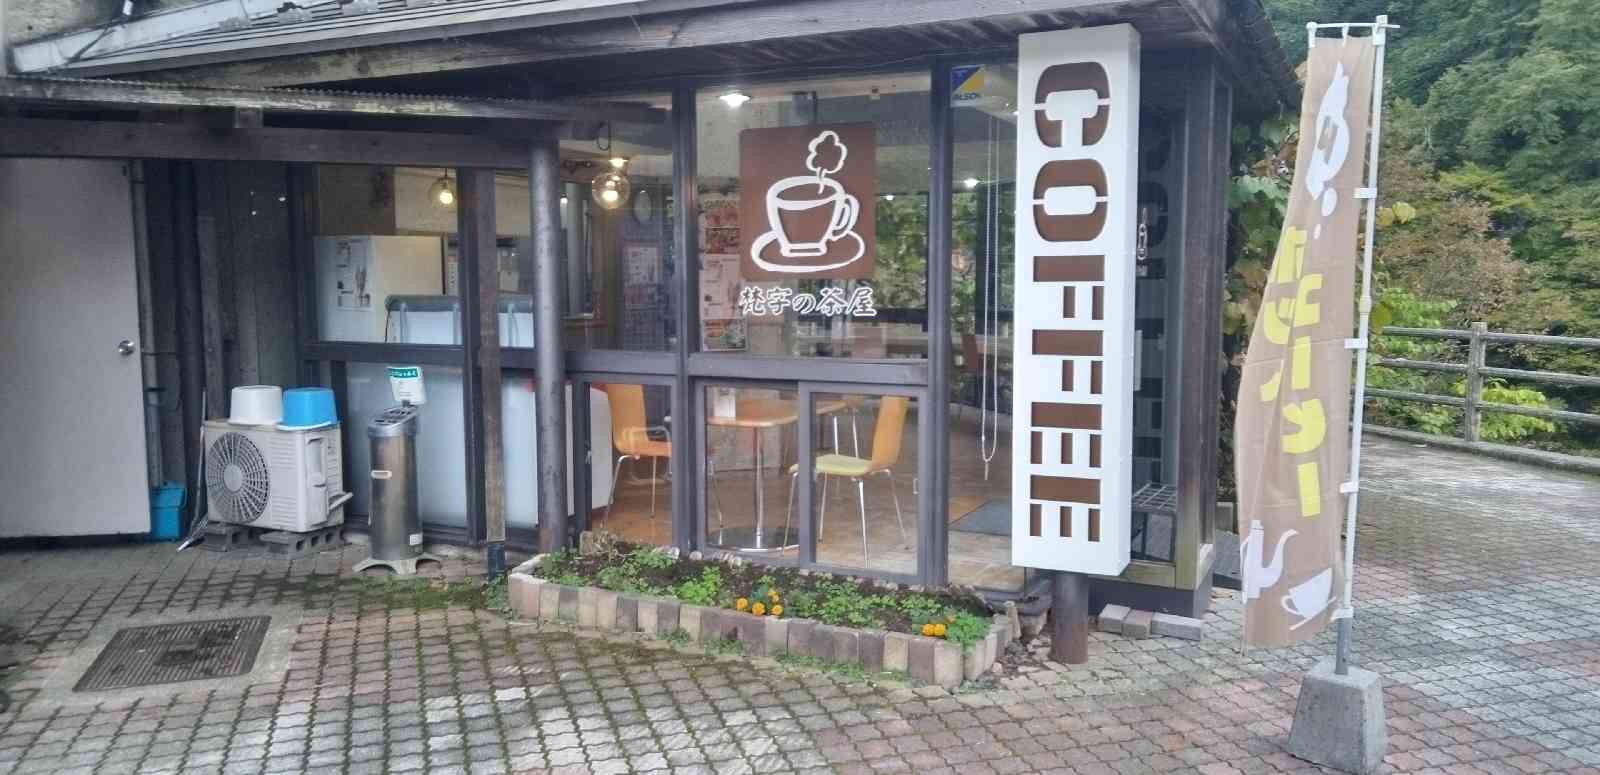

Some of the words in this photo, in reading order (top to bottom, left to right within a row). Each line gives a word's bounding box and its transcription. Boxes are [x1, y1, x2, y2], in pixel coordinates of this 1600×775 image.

[739, 286, 877, 316] 梵字の茶屋
[1030, 61, 1110, 542] COFFEE
